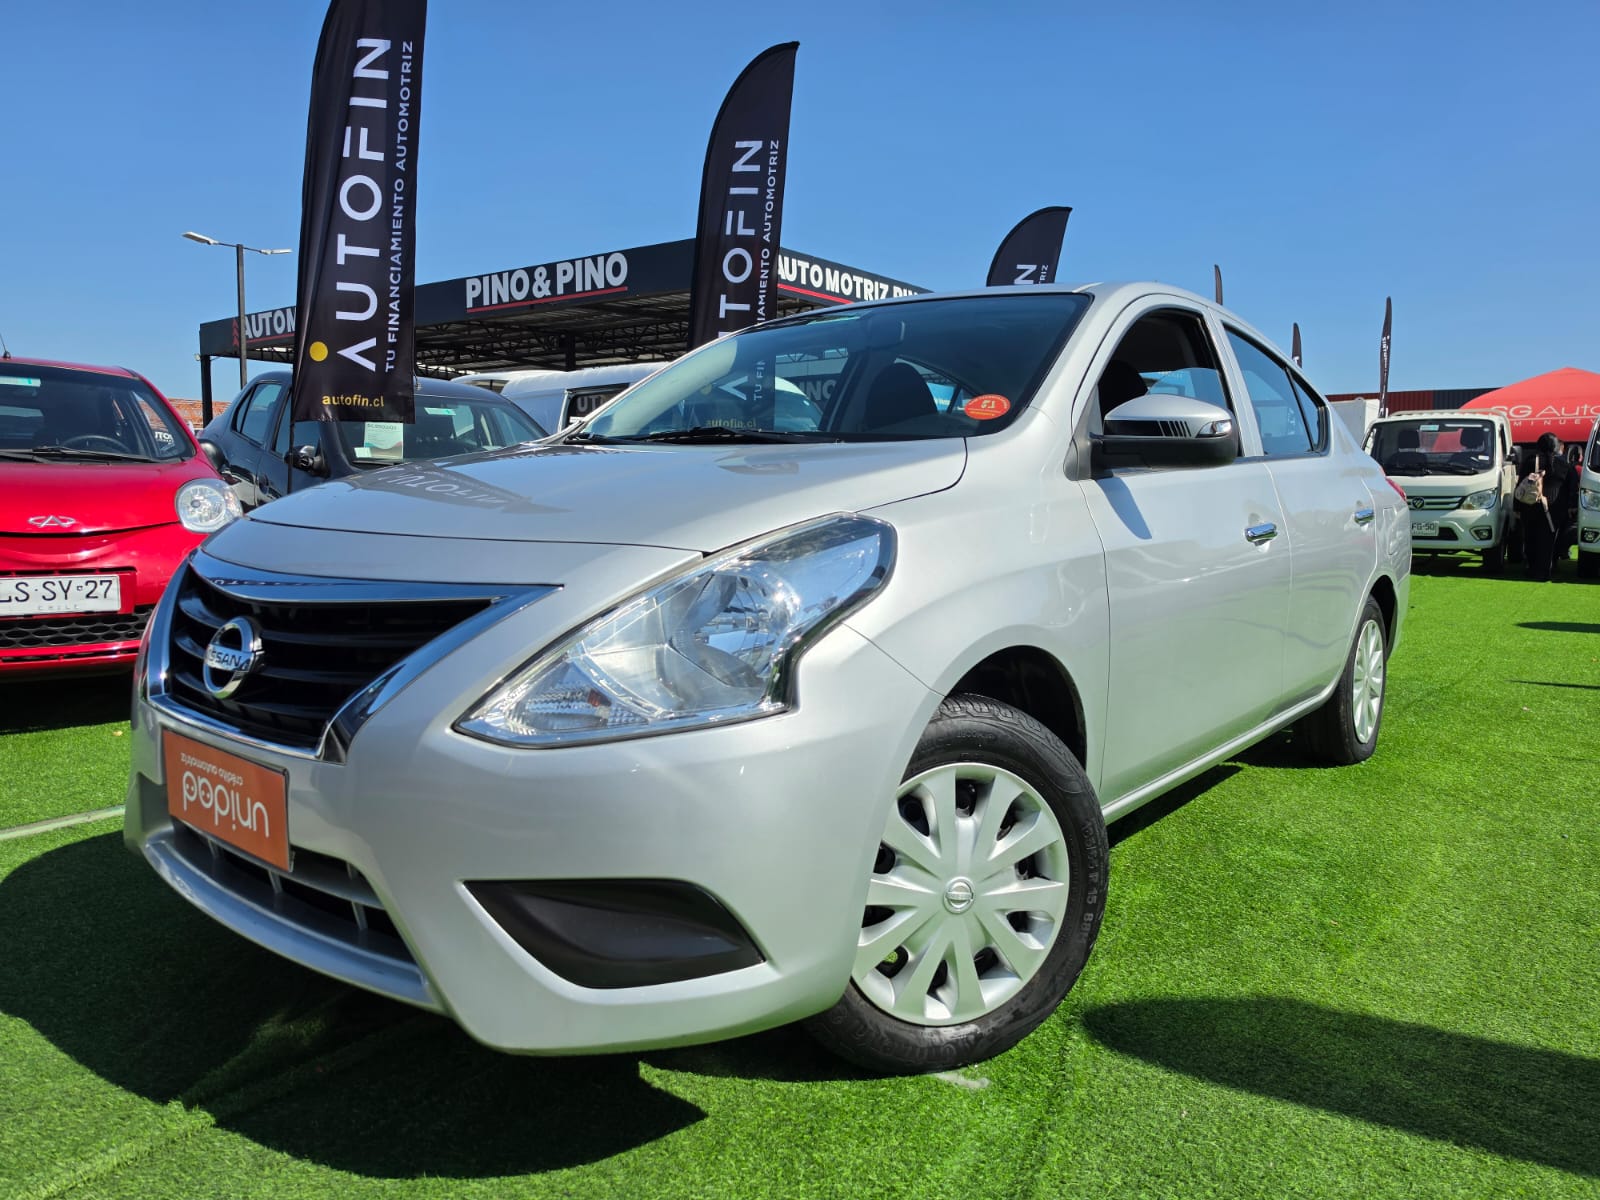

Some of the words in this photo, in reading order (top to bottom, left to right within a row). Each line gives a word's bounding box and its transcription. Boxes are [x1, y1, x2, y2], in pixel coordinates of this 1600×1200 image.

[395, 40, 413, 171] AUTOMOTRIZ
[335, 37, 392, 373] AUTOFIN
[762, 139, 780, 243] AUTOMOTRIZ
[387, 178, 404, 343] FINANCIAMIENTO
[321, 394, 385, 408] autofin.cl
[385, 349, 396, 373] TU
[182, 771, 270, 838] unidad
